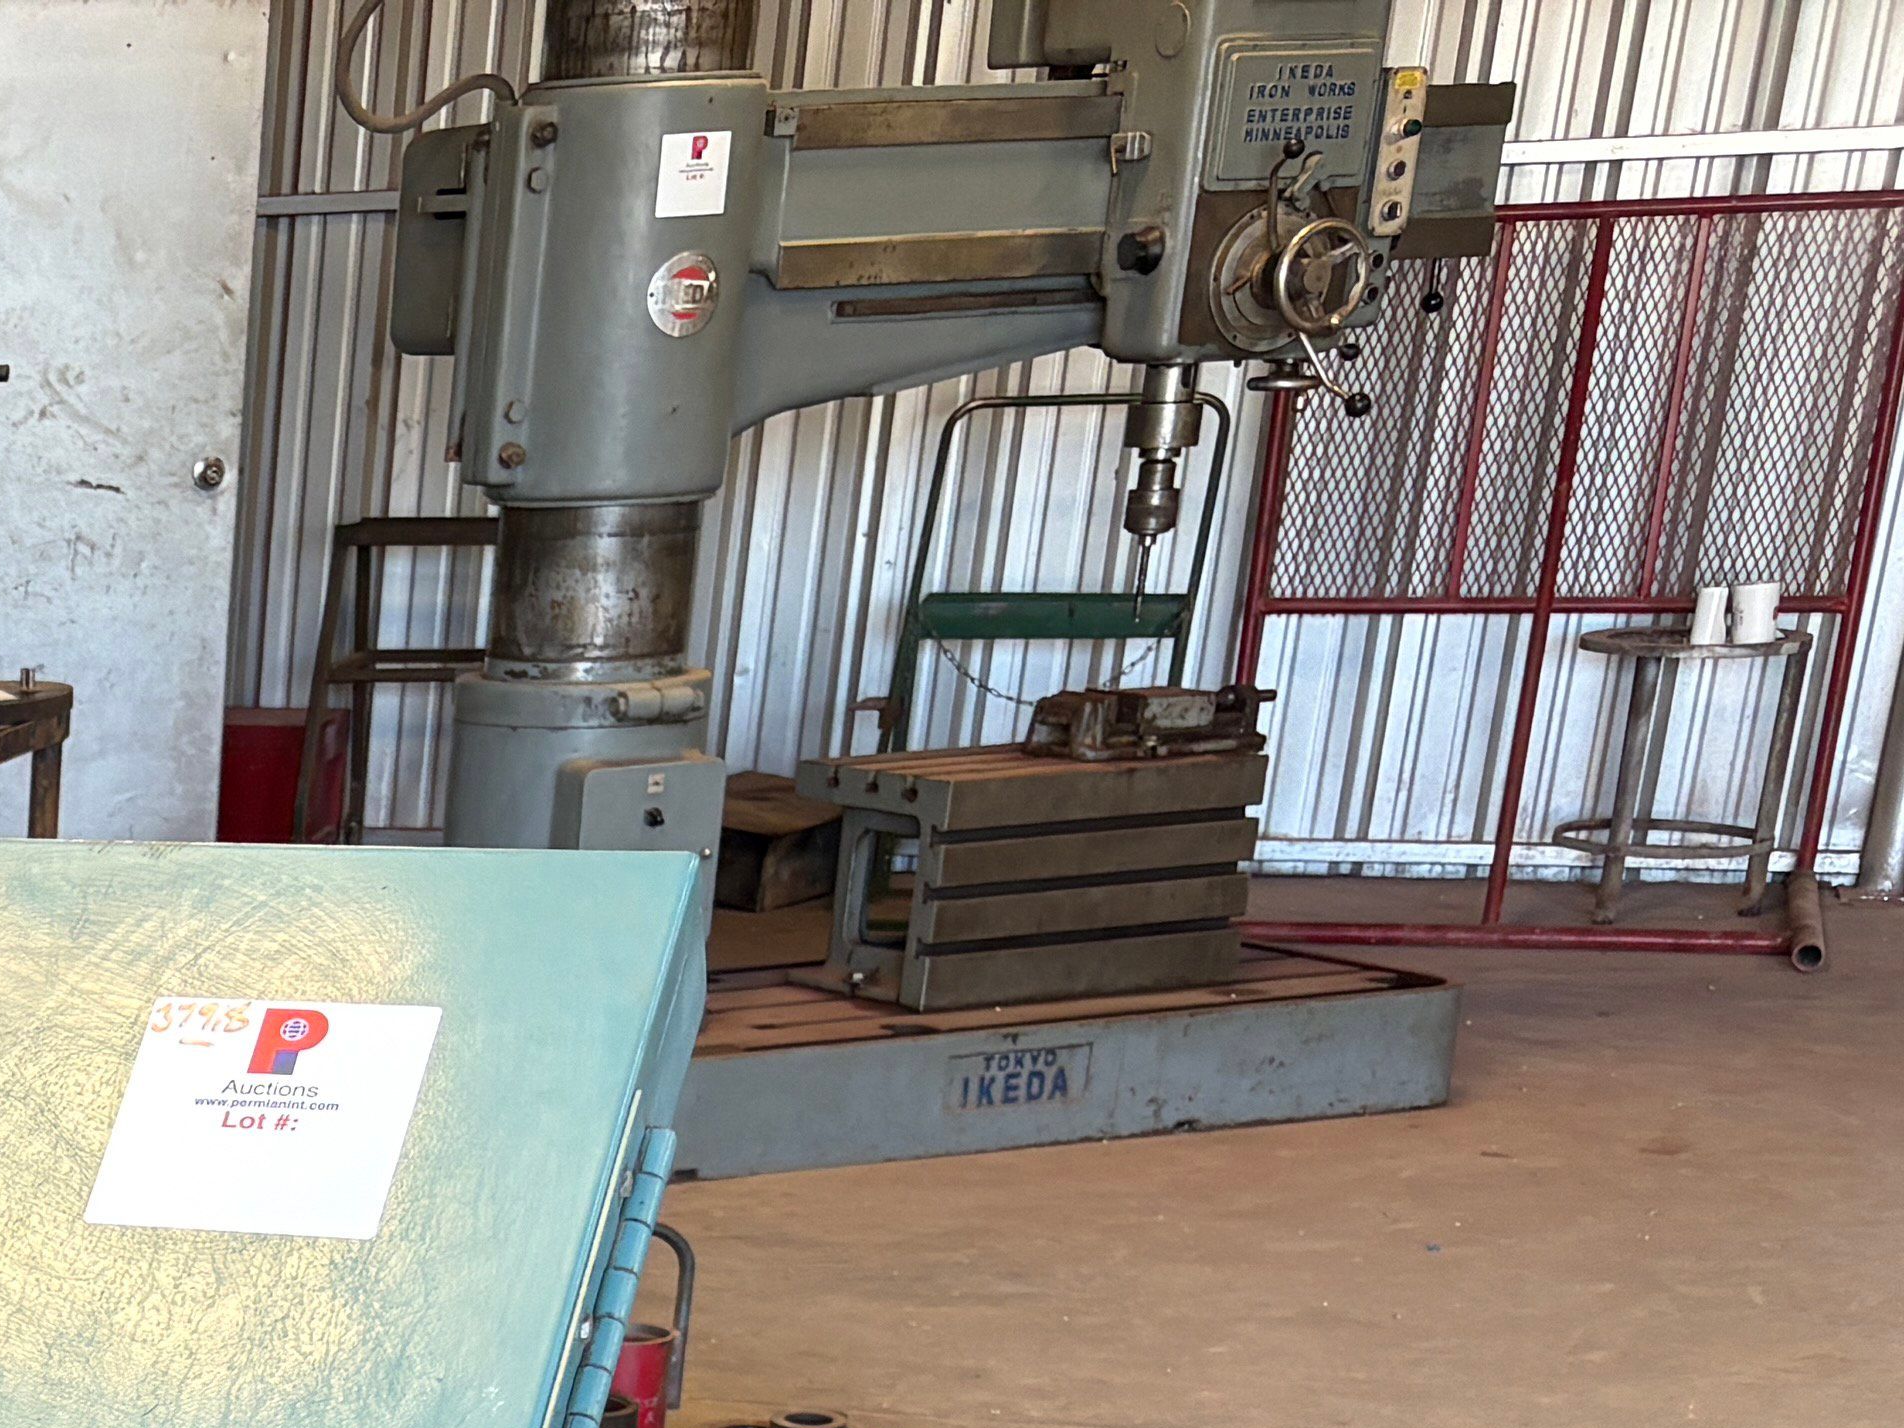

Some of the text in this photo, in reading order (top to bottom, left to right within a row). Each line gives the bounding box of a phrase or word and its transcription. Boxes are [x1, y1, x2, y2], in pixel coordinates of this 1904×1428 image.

[1277, 63, 1334, 81] IKEDA
[1248, 81, 1356, 100] IRON WORKS
[1246, 105, 1353, 123] ENTERPRISE
[1243, 124, 1351, 143] MINNEAPOLIS
[983, 1050, 1057, 1071] TOKYO
[221, 1079, 319, 1098] Auctions
[959, 1066, 1068, 1108] IKEDA
[195, 1097, 339, 1111] www.permianint.com
[221, 1111, 299, 1131] Lot #:
